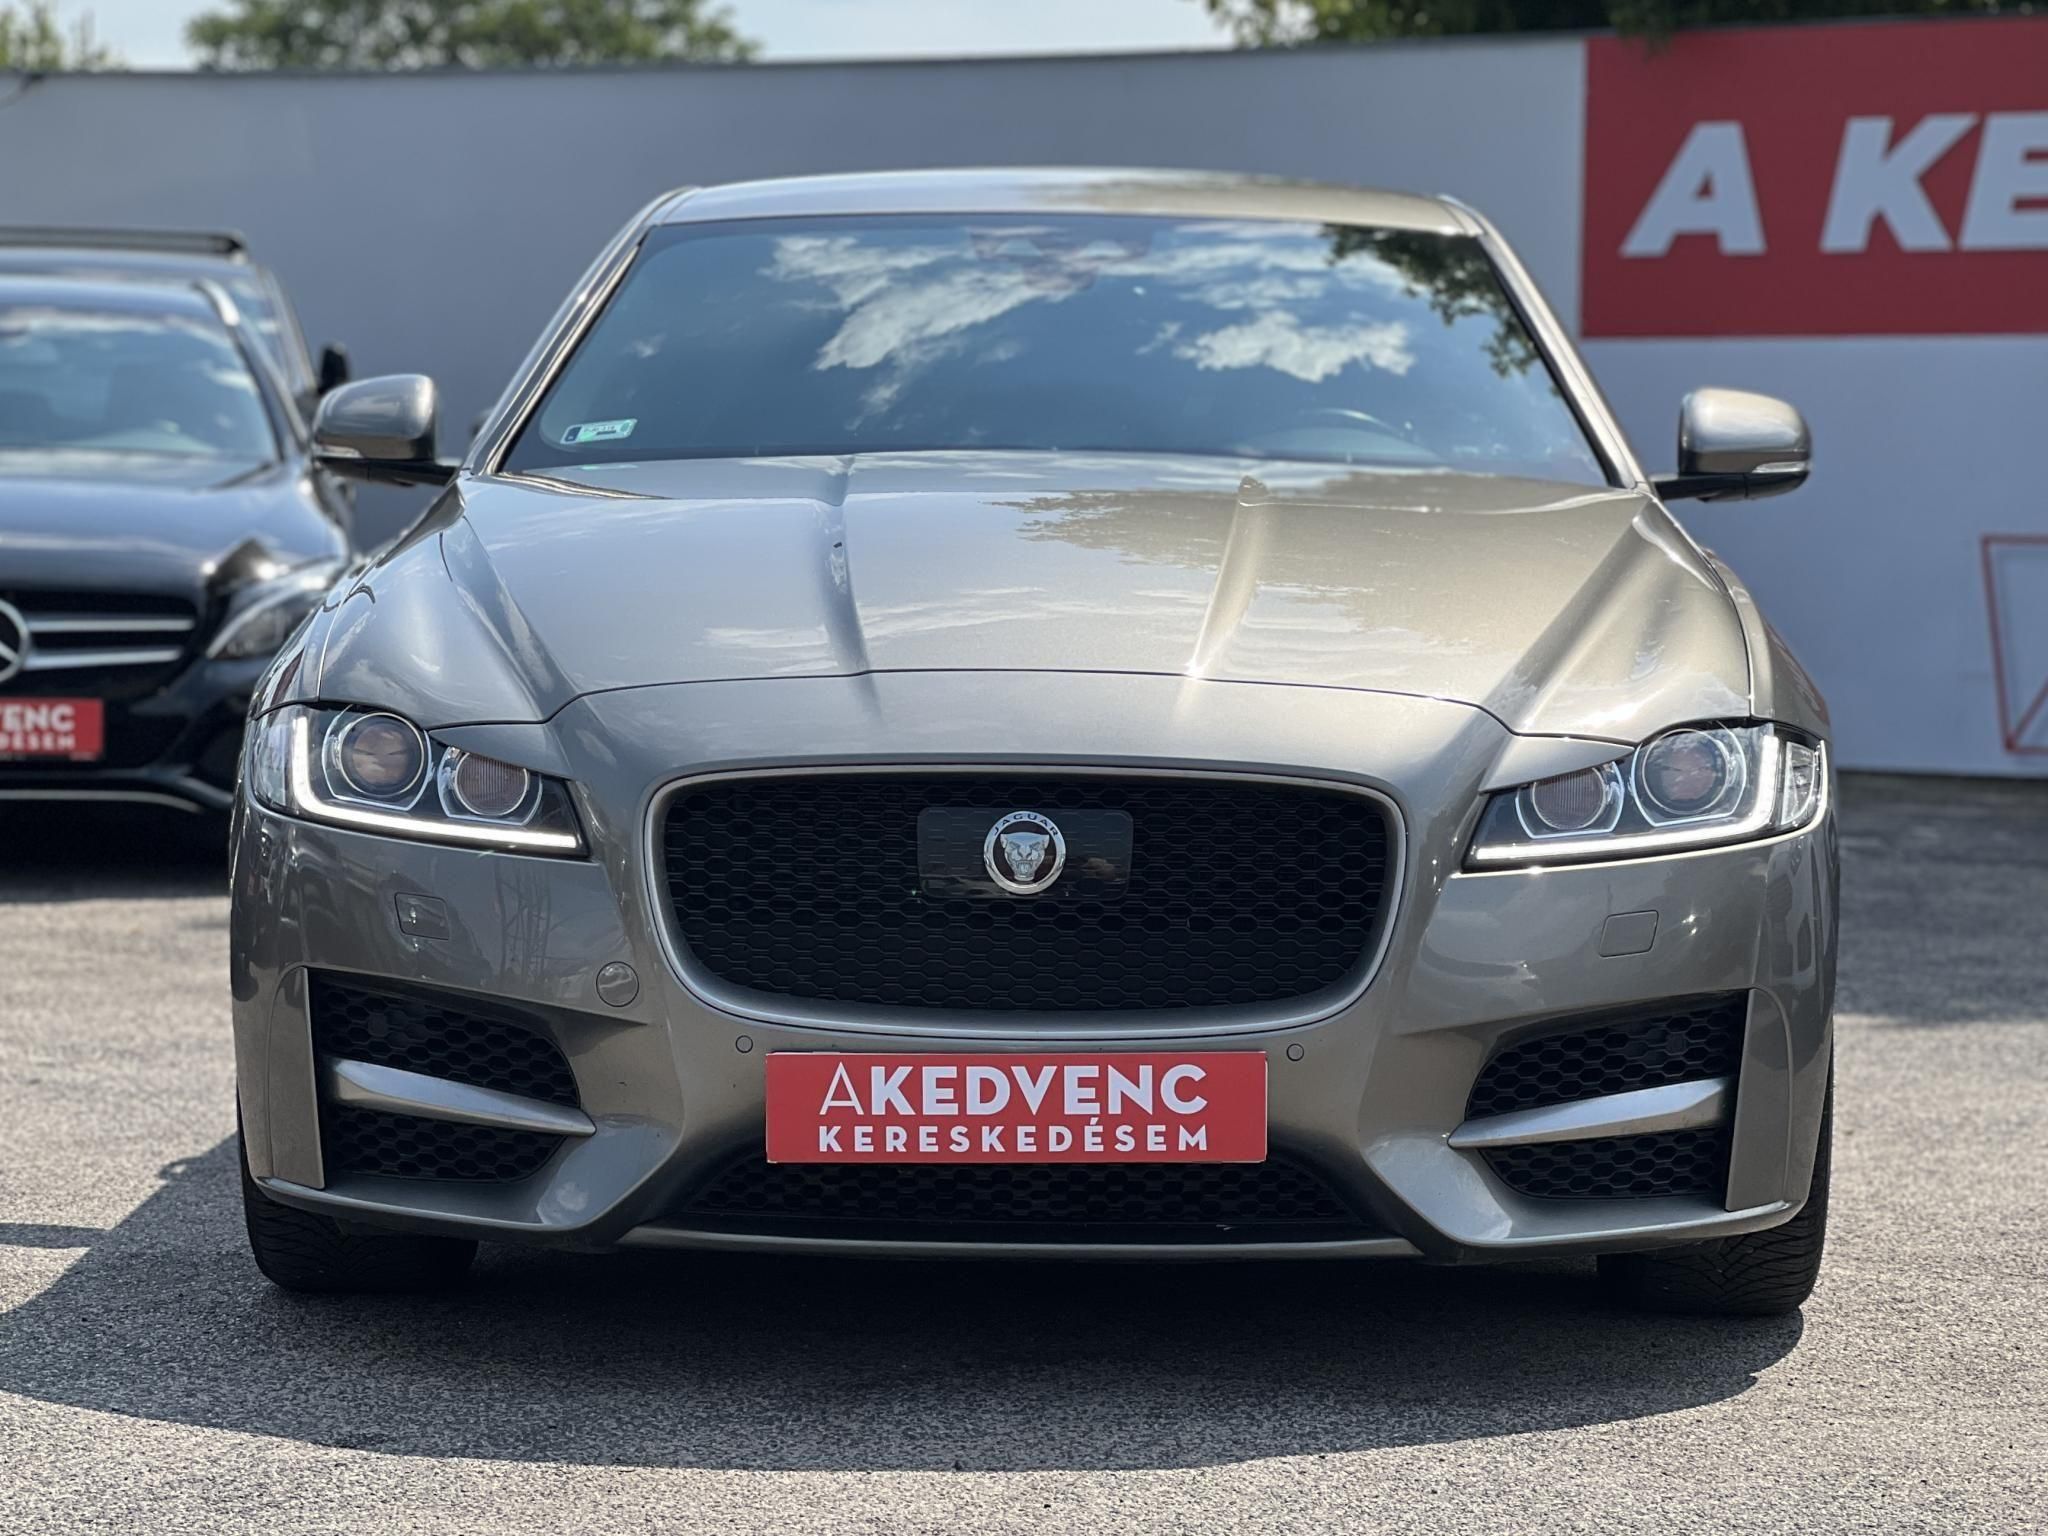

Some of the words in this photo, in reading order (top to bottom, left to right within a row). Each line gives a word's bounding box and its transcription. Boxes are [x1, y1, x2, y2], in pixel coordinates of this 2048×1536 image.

[1621, 121, 1767, 257] A
[1820, 111, 2048, 252] KE
[0, 703, 75, 733] ENC
[993, 813, 1059, 836] JAGUAR
[819, 1061, 1208, 1116] AKEDVENC
[818, 1118, 1208, 1153] KERESKEDÉSEM
